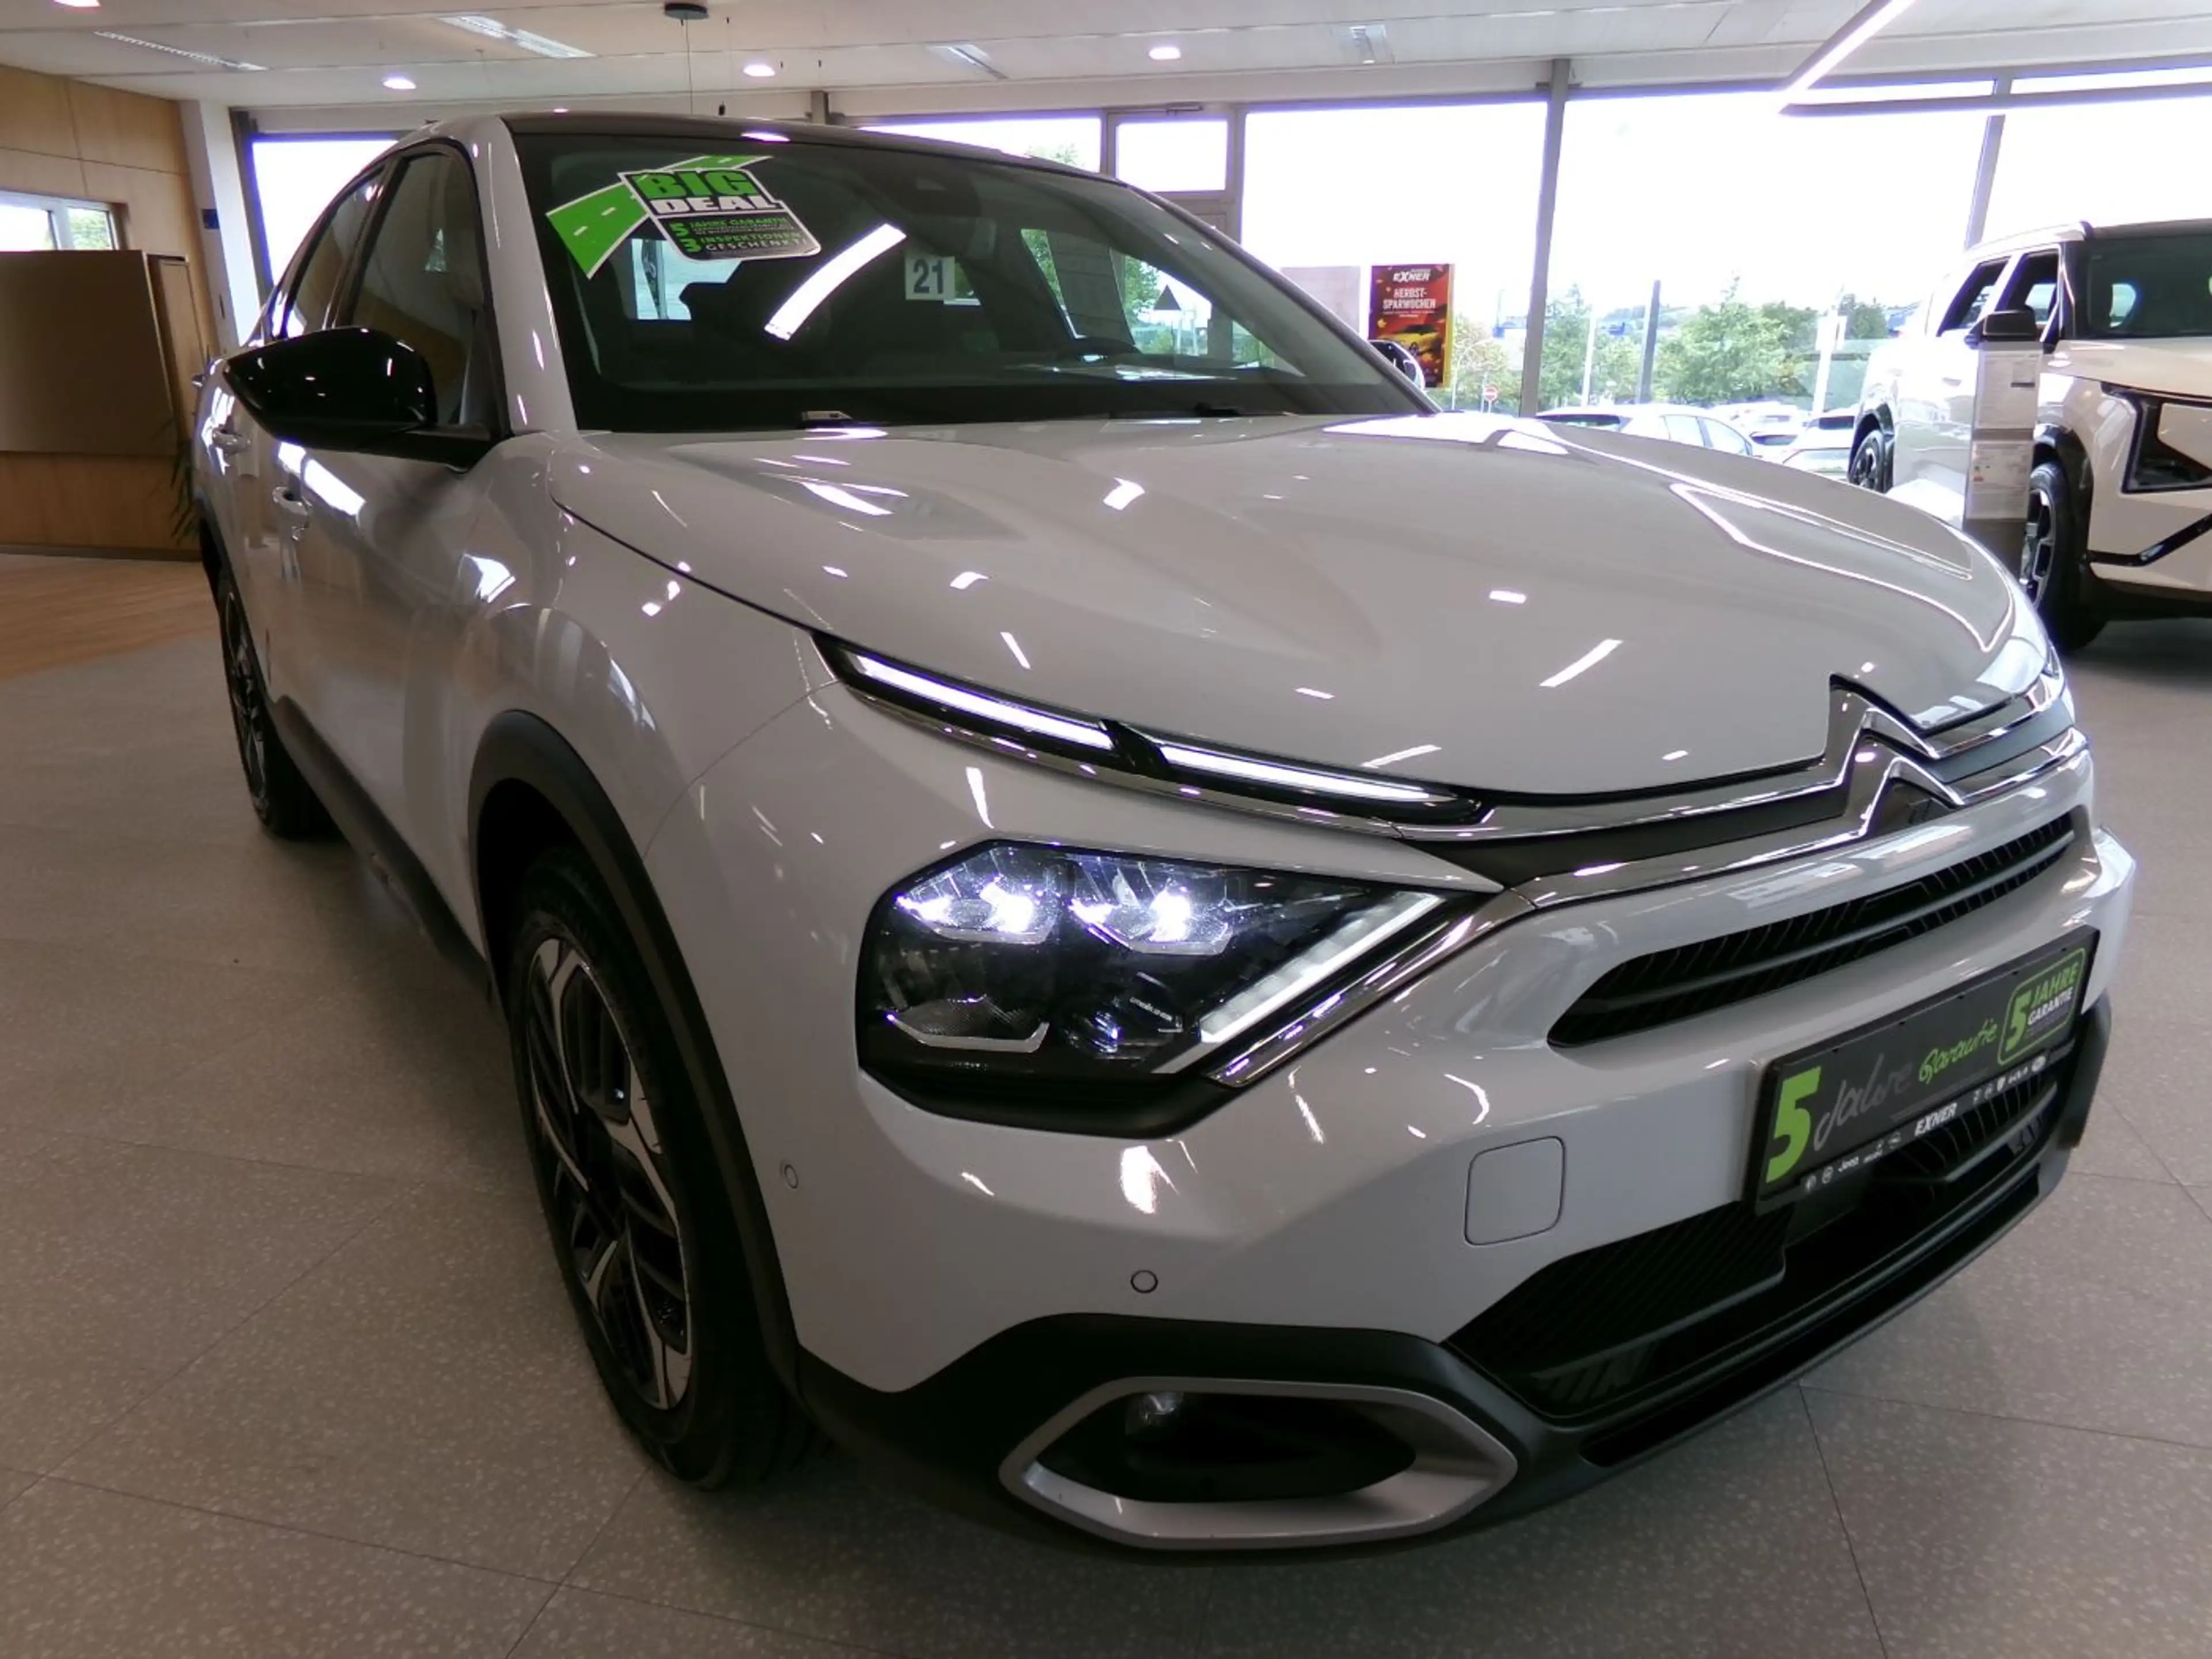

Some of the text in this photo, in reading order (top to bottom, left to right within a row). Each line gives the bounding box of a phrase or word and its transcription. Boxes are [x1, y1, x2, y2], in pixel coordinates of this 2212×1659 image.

[634, 170, 758, 199] BIG
[651, 195, 777, 214] DEAL
[669, 222, 690, 237] 5
[679, 238, 702, 252] 3
[913, 259, 944, 294] 21
[2005, 989, 2032, 1052] 5
[2030, 961, 2079, 1009] JAHRE
[2027, 986, 2074, 1025] GARANTIE
[1766, 1065, 1821, 1183] 5
[1914, 1102, 1957, 1137] EXNER
